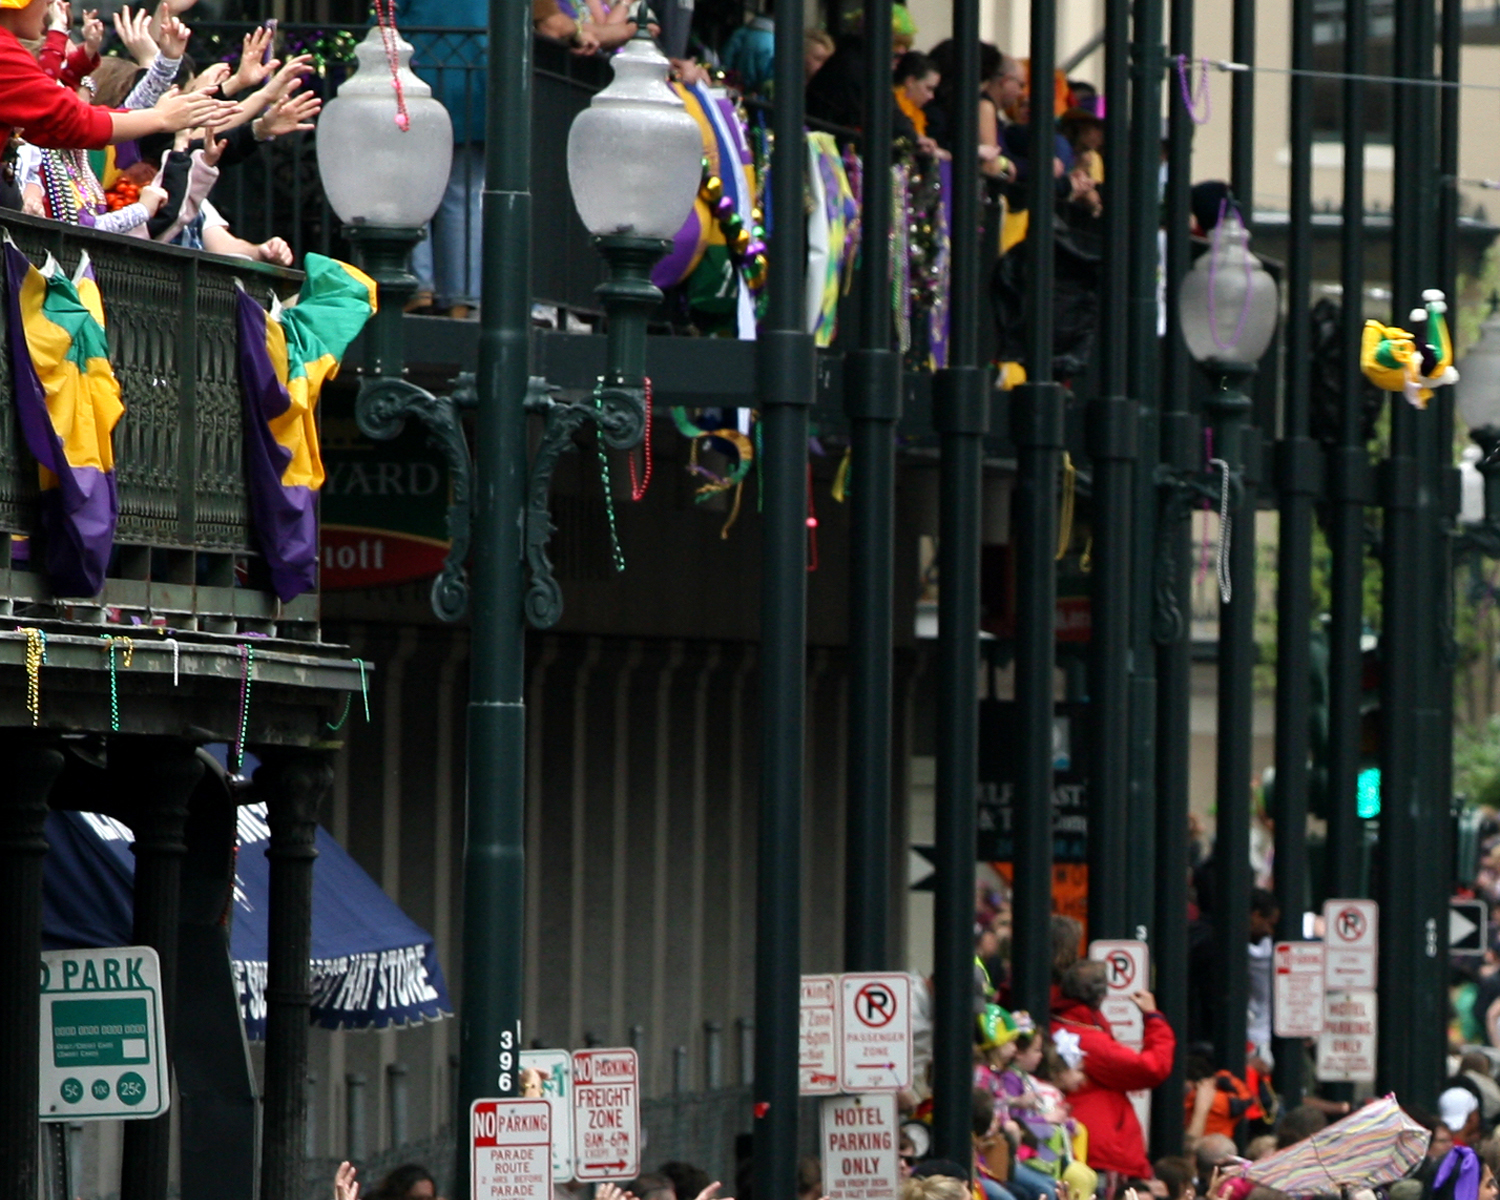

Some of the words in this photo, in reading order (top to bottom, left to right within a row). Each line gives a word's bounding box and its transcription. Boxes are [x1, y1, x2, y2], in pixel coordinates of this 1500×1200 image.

[62, 957, 146, 989] PARK
[333, 953, 378, 1010] HAT
[376, 943, 439, 1010] STORE
[846, 1032, 905, 1042] PASSENGER
[498, 1030, 514, 1092] 396
[863, 1046, 888, 1057] ZONE
[574, 1058, 592, 1081] NO
[595, 1060, 634, 1078] PARKING
[120, 1082, 142, 1096] 25¢
[577, 1087, 632, 1107] FREIGHT
[474, 1111, 496, 1138] NO
[498, 1114, 548, 1133] PARKING
[588, 1109, 623, 1129] ZONE
[834, 1107, 884, 1127] HOTEL
[829, 1132, 892, 1151] PARKING
[490, 1149, 534, 1161] PARADE
[494, 1162, 530, 1174] ROUTE
[842, 1157, 880, 1176] ONLY
[514, 1174, 543, 1184] BEFORE
[490, 1184, 535, 1197] PARADE
